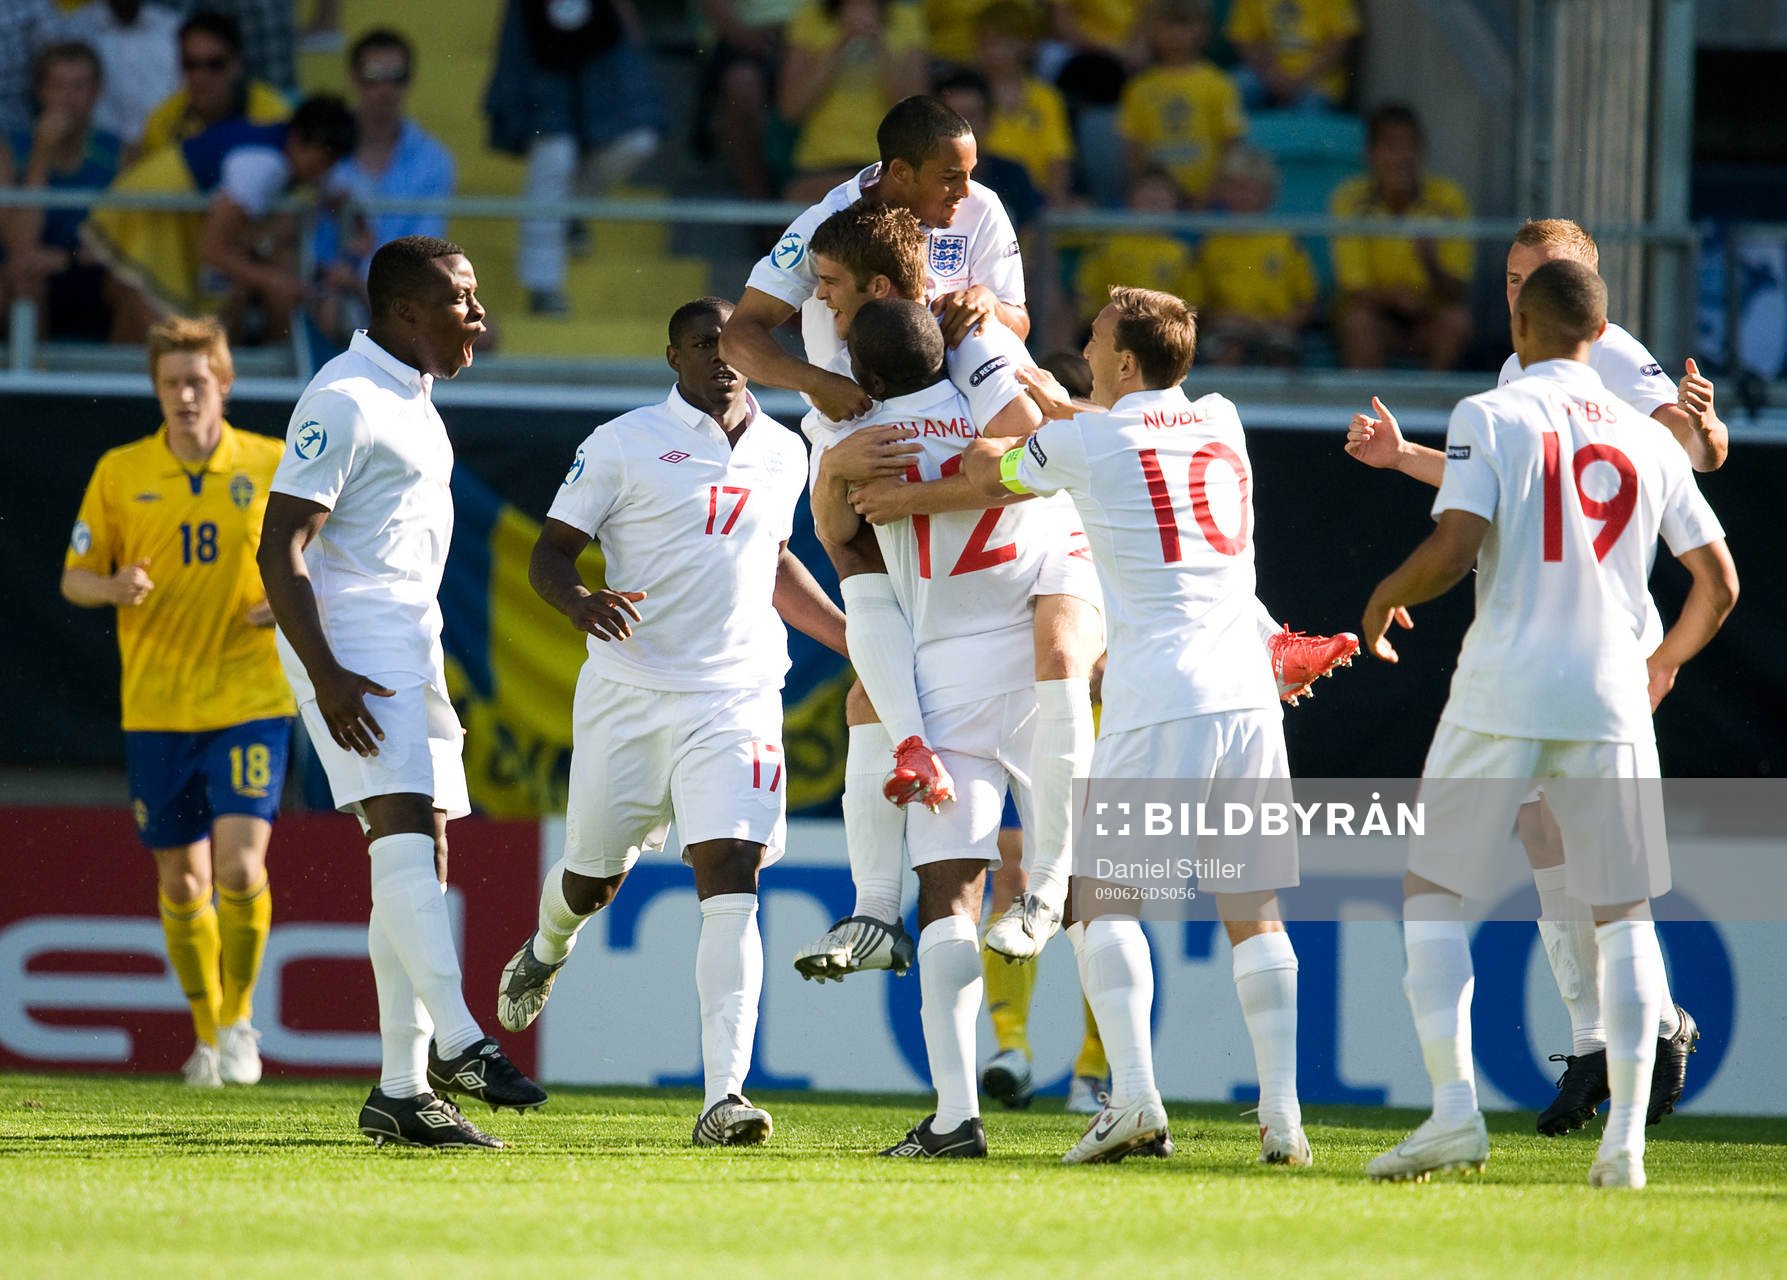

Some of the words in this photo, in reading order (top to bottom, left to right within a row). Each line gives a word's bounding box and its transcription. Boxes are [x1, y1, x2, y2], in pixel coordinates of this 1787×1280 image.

[705, 486, 752, 535] 17
[904, 452, 1017, 579] 12
[1138, 442, 1249, 564] 10
[1542, 432, 1639, 563] 19
[179, 521, 219, 566] 18
[229, 743, 271, 790] 18
[752, 741, 783, 793] 17
